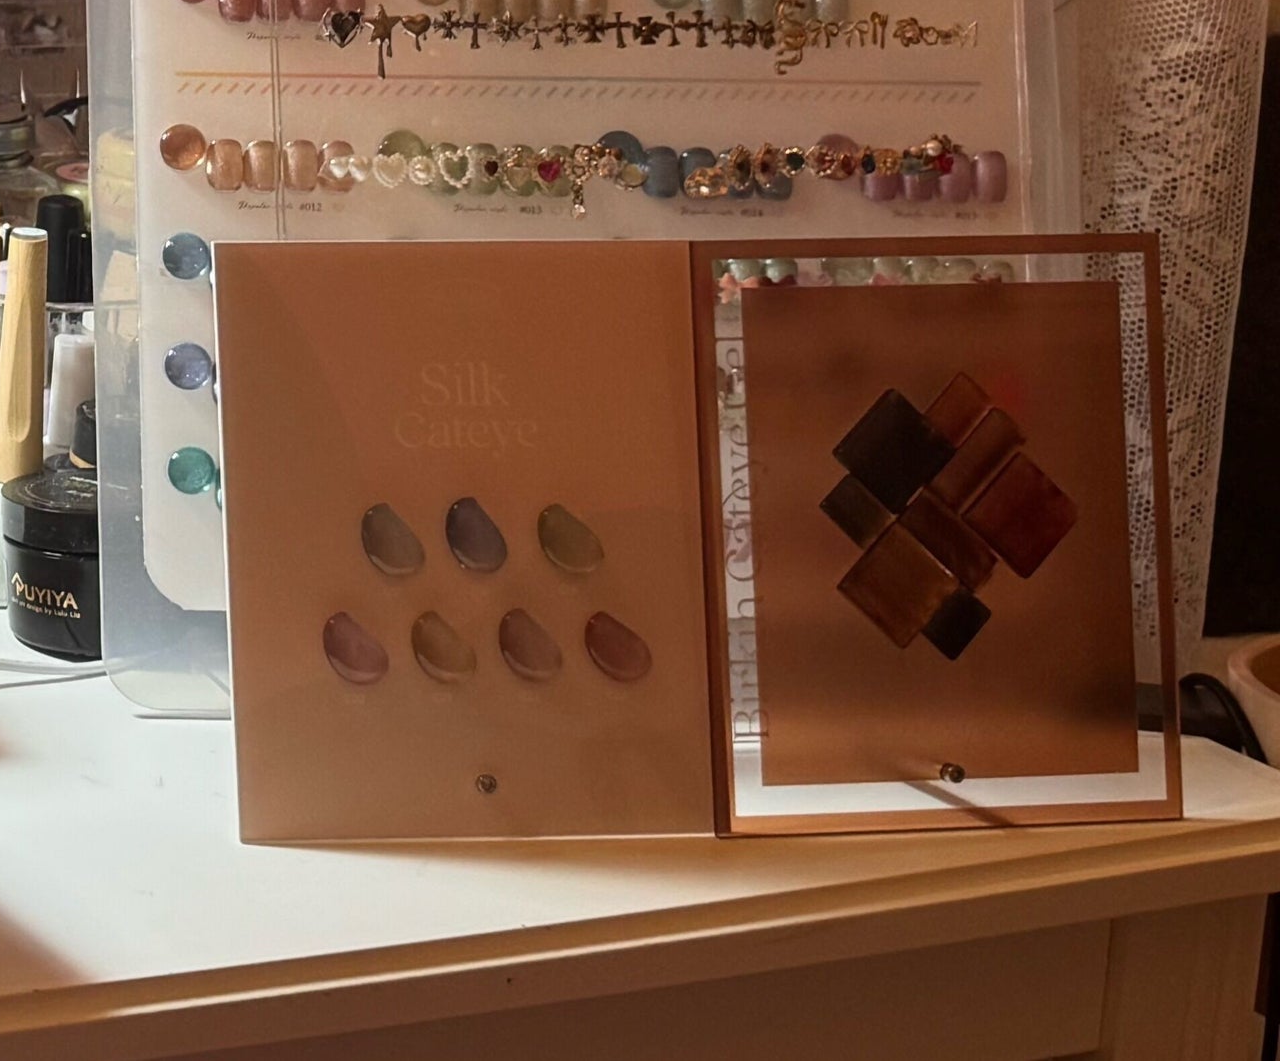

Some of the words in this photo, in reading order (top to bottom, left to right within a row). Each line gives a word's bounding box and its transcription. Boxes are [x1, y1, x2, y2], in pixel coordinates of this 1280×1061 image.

[298, 202, 323, 212] #012
[419, 360, 510, 408] Silk
[394, 411, 538, 459] Cateye
[729, 596, 769, 742] Birkin
